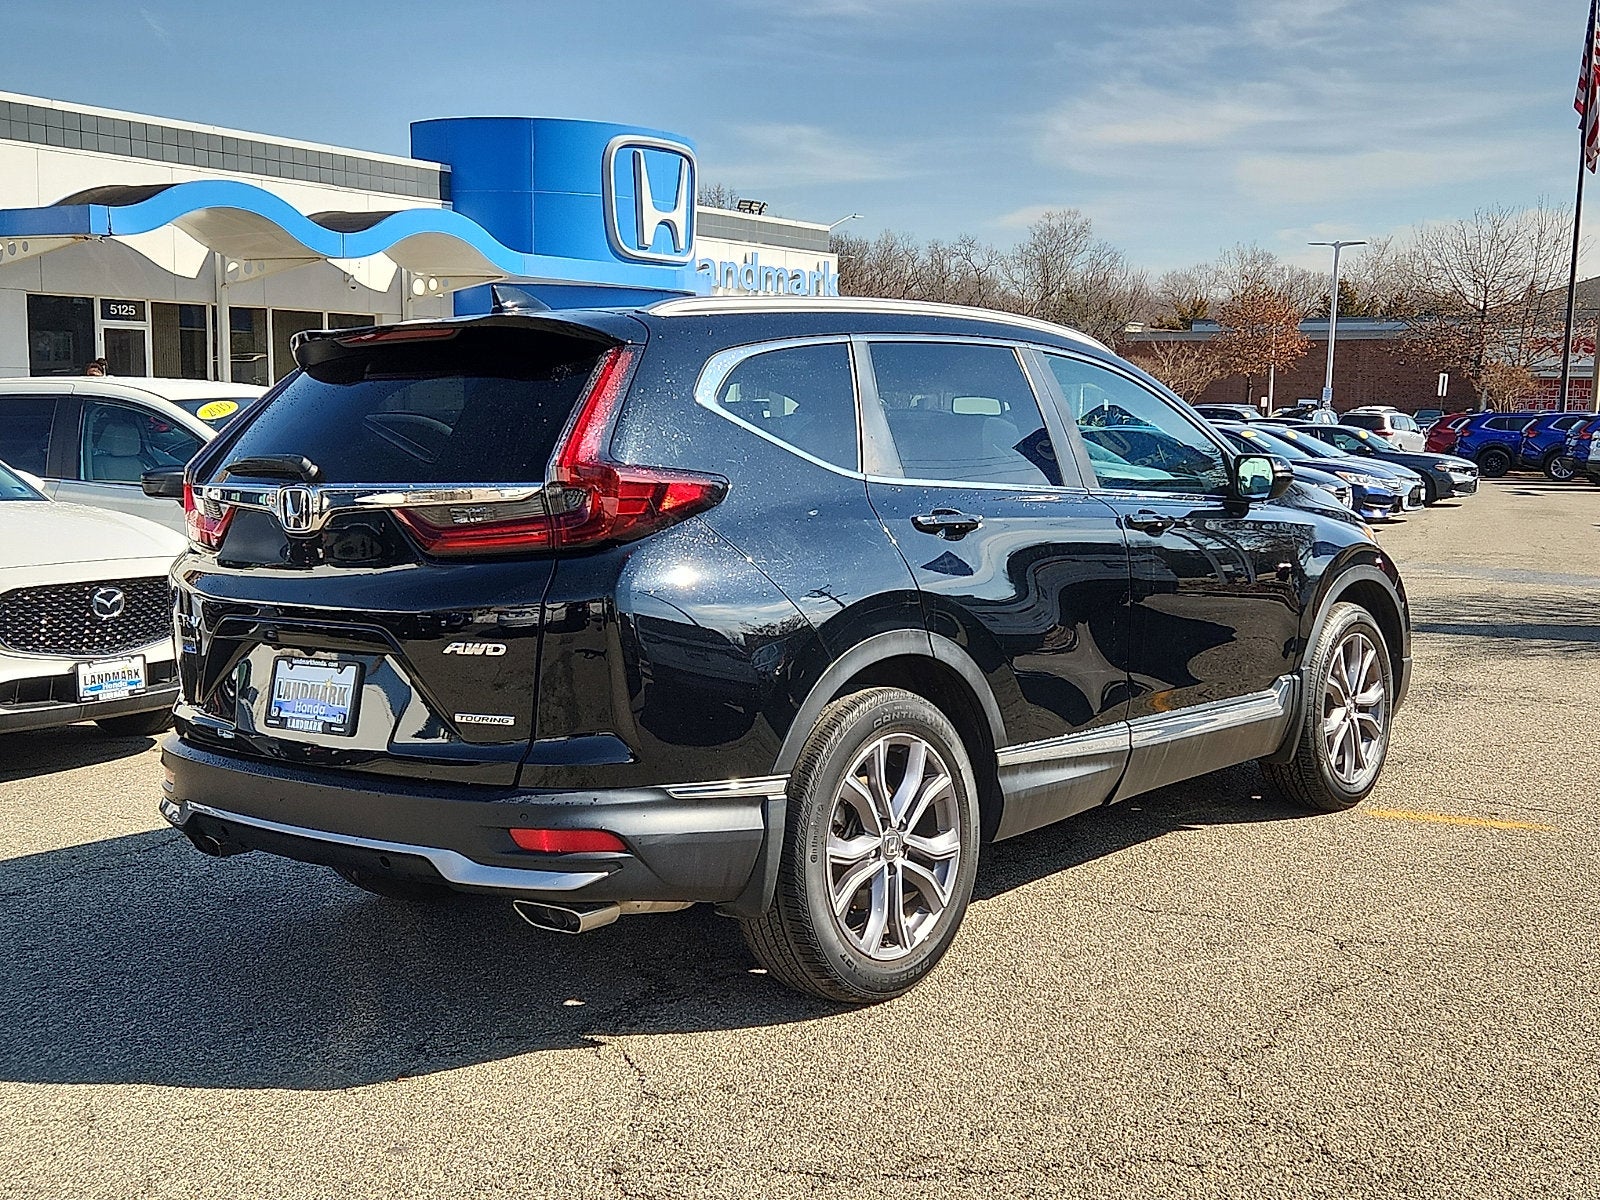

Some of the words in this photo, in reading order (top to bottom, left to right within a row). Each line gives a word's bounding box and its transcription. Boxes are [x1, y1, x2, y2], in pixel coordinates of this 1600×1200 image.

[110, 304, 136, 316] 5125
[443, 642, 507, 656] AWD
[83, 669, 140, 686] LANDMARK
[276, 680, 349, 707] LANDMARK
[295, 701, 326, 715] Honda
[286, 718, 324, 732] LANDMARK
[459, 714, 510, 724] TOURING
